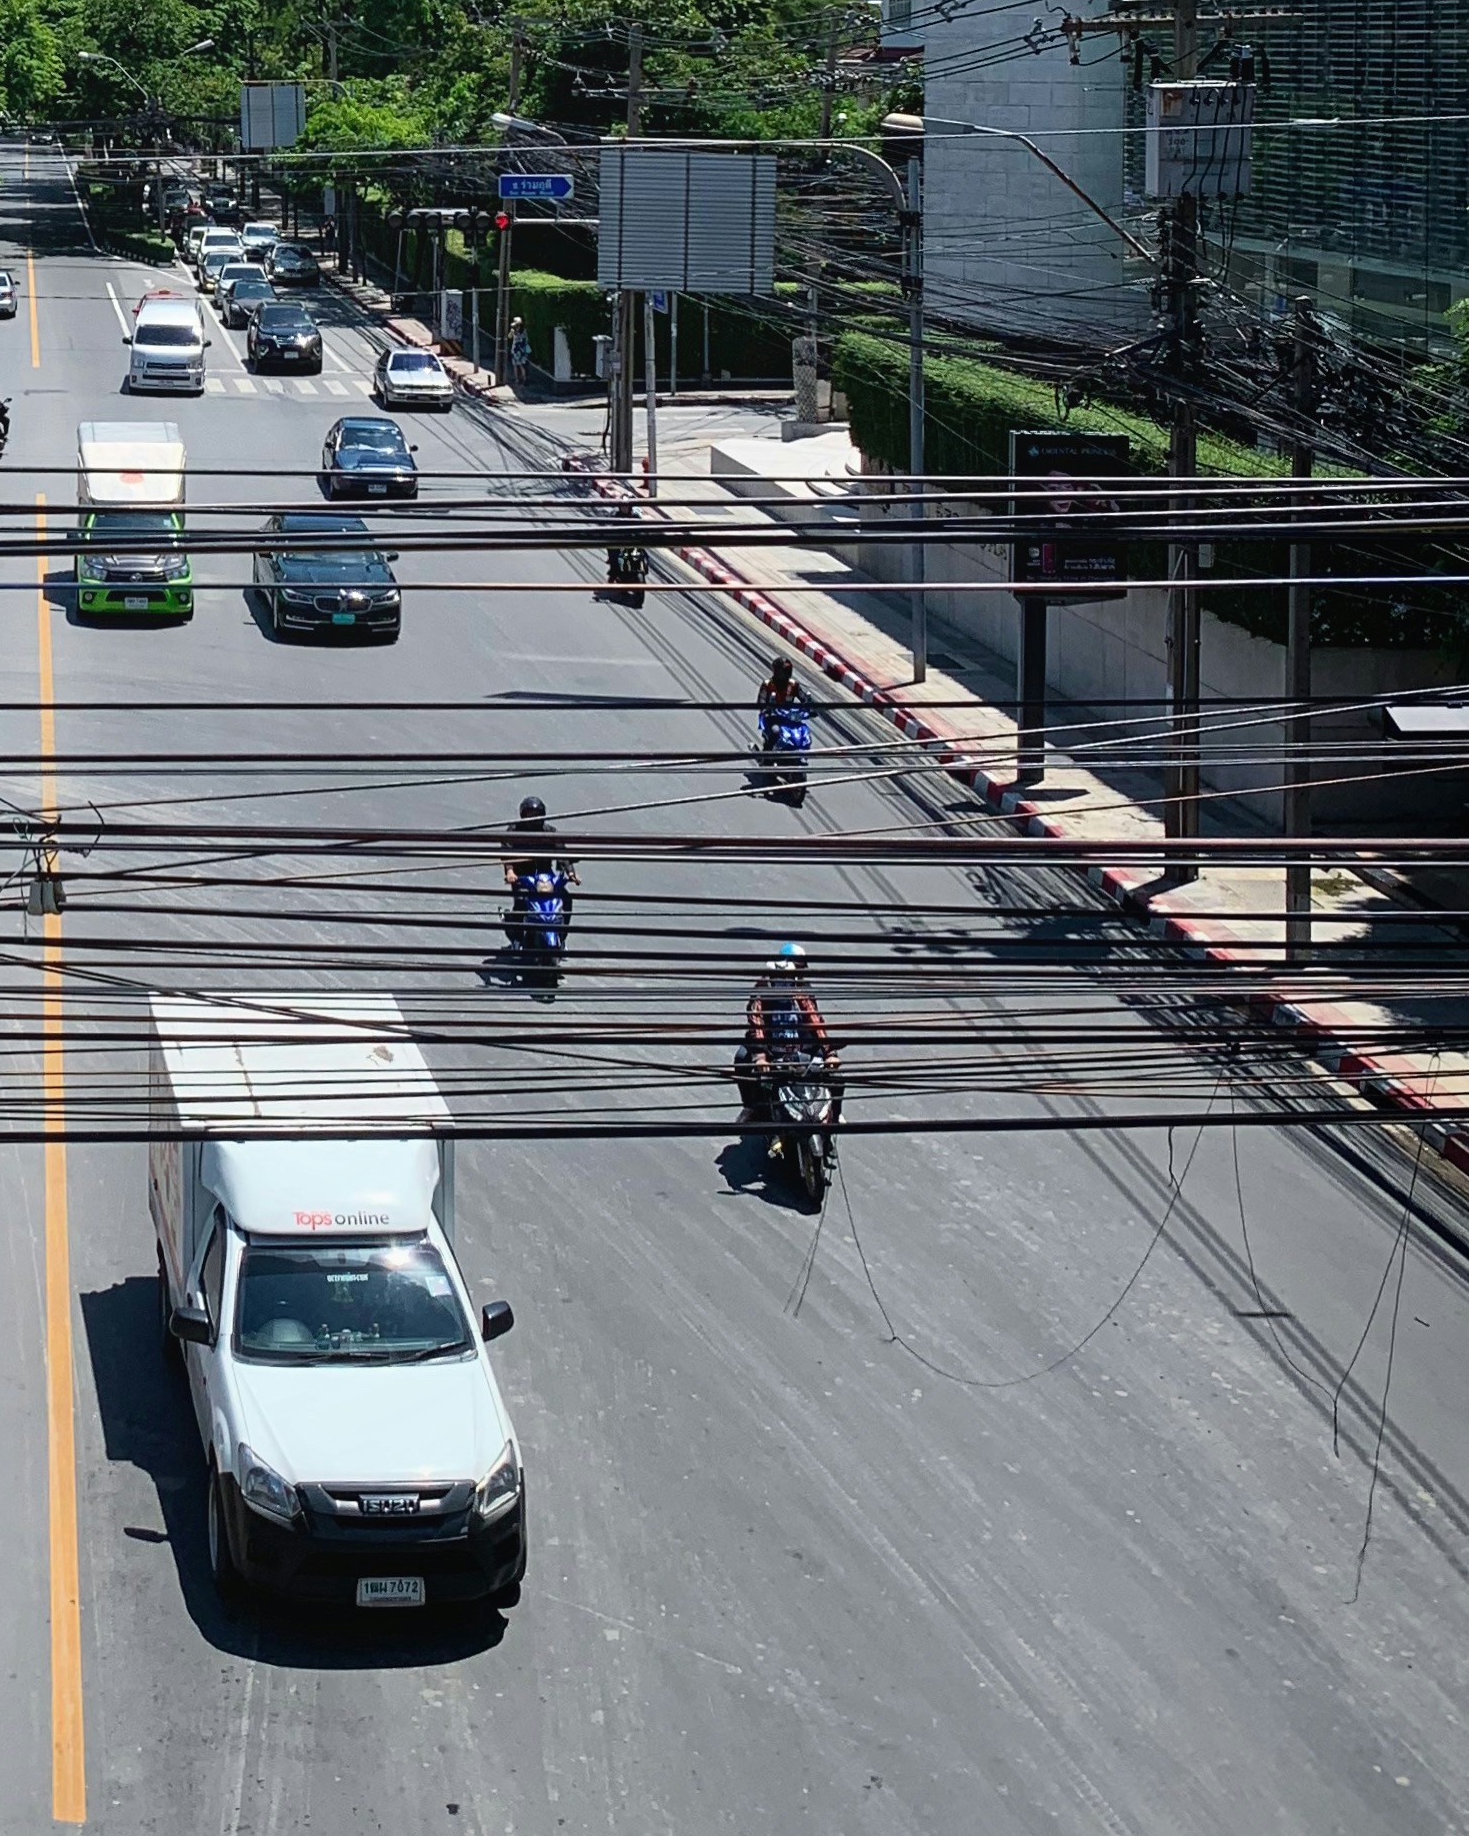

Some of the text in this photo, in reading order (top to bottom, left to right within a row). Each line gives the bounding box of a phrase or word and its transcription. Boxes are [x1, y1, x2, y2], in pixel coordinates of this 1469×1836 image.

[292, 1211, 390, 1231] Tops online
[362, 1498, 418, 1514] ISUZU
